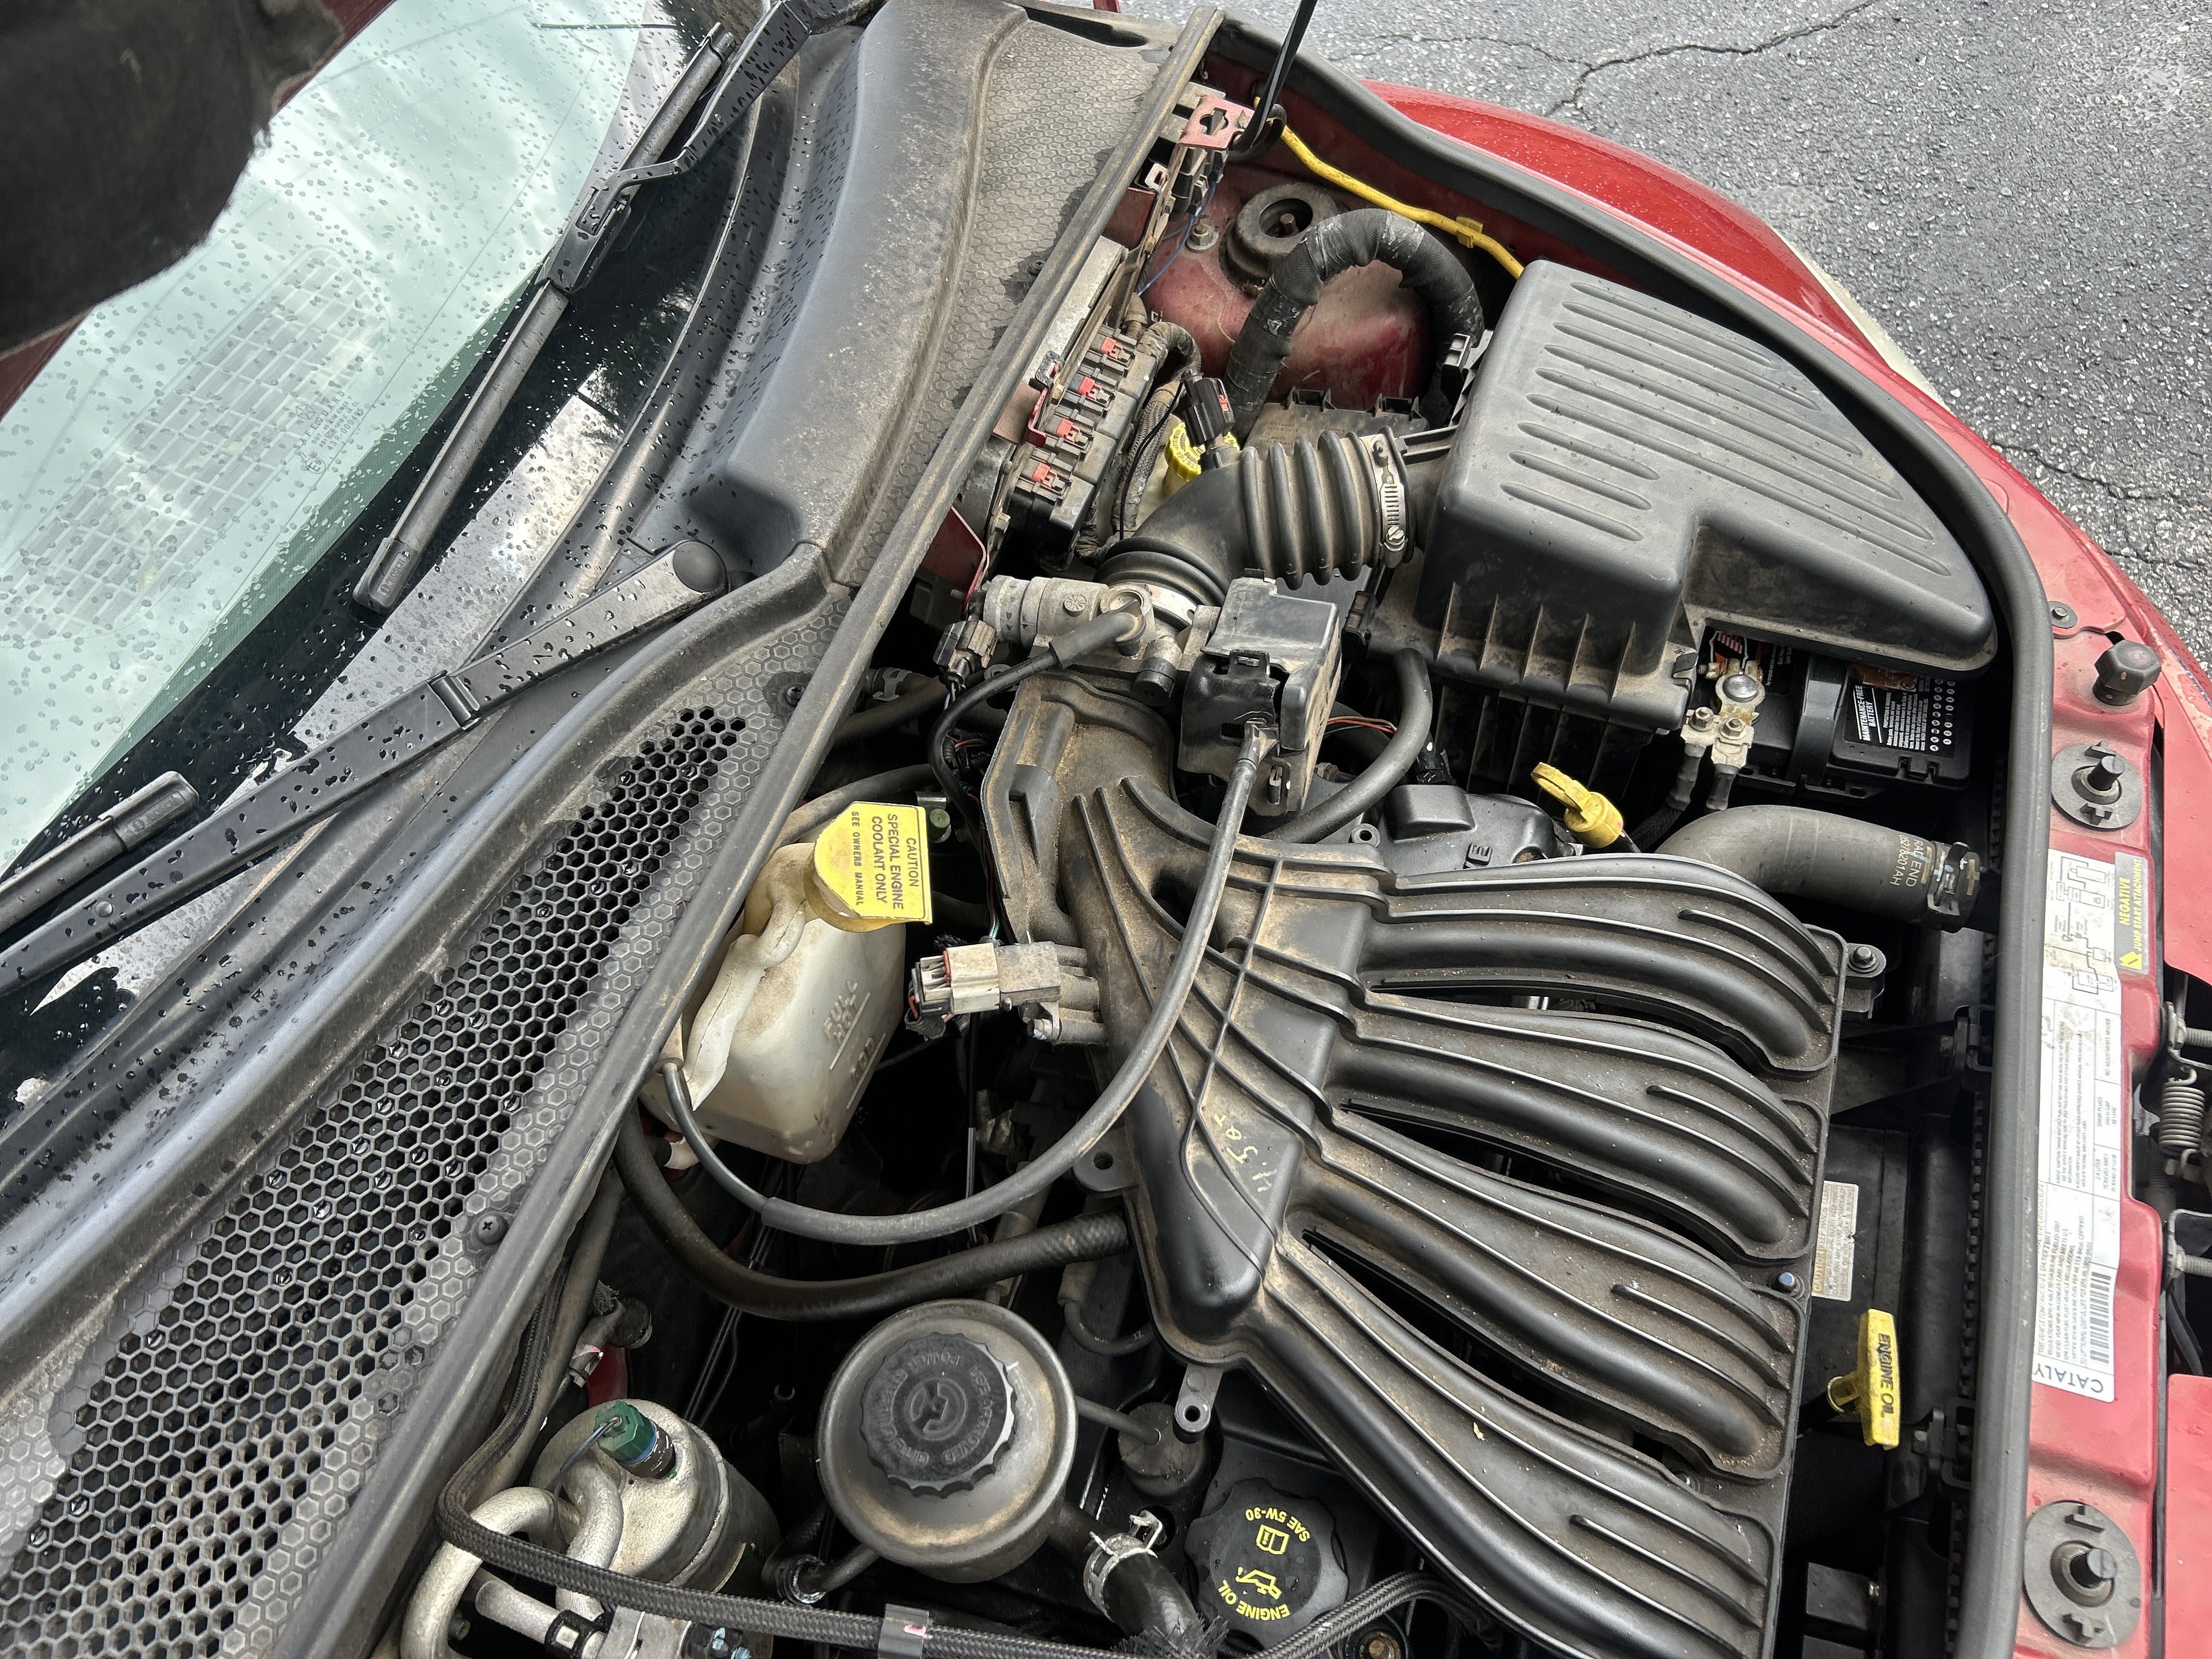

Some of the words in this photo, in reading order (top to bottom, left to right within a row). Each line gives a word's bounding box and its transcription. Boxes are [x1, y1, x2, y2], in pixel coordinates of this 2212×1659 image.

[292, 389, 346, 451] SAFEGUARD
[1855, 685, 1871, 742] MAINTENANCE-FREE
[1865, 701, 1877, 728] BATTERY
[851, 811, 860, 827] SEE
[853, 832, 862, 867] OWNERS
[872, 816, 885, 871] COOLANT
[888, 814, 900, 862] SPECIAL
[1913, 839, 1923, 857] RAD
[906, 838, 919, 887] CAUTION
[1906, 860, 1922, 887] END
[855, 872, 864, 905] MANUAL
[875, 873, 888, 903] ONLY
[890, 865, 904, 909] ENGINE
[2134, 858, 2142, 906] ATTACHMENT
[2119, 877, 2130, 925] NEGATIVE
[2134, 907, 2142, 929] START
[2134, 930, 2142, 951] JUMP
[823, 979, 858, 1036] FULL
[833, 994, 857, 1046] HOT
[850, 1036, 874, 1085] ADD
[1821, 1184, 1830, 1204] CLEAR
[1837, 1187, 1847, 1229] AUTOMATICALLY
[1819, 1206, 1827, 1228] HANDS
[1817, 1231, 1826, 1249] KEEP
[1812, 1250, 1825, 1292] CAUTION
[1839, 1268, 1848, 1296] WHETHER
[1878, 1333, 1894, 1390] ENGINE
[969, 1363, 991, 1395] USE
[1880, 1392, 1894, 1418] OIL
[1245, 1507, 1287, 1523] 5W-30
[1286, 1516, 1310, 1542] SAE
[1218, 1579, 1237, 1605] OIL
[1235, 1600, 1290, 1621] ENGINE
